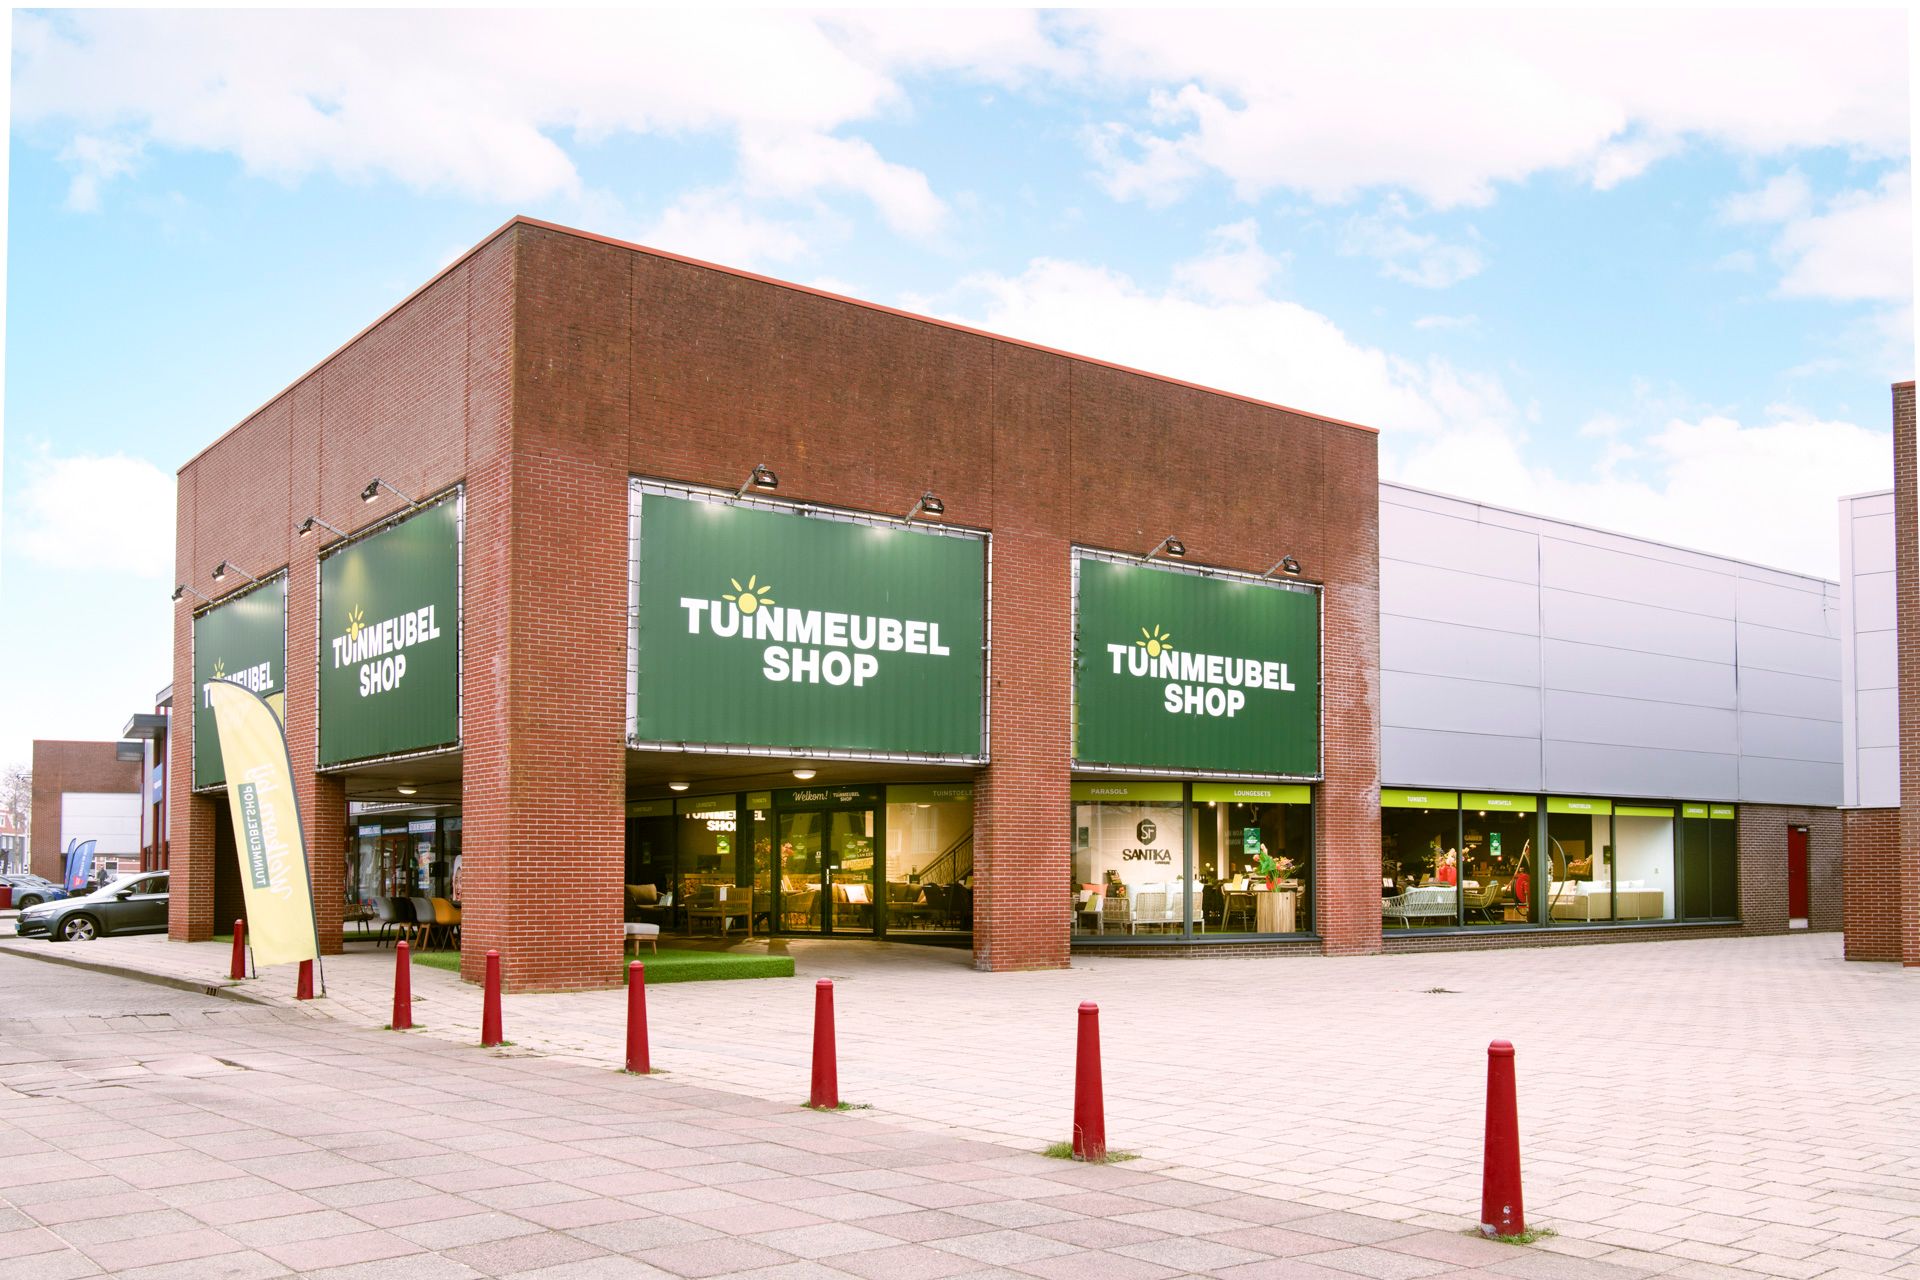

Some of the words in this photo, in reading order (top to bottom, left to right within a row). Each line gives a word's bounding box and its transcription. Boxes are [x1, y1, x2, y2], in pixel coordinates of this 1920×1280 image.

[332, 604, 440, 669] TUINMEUBEL
[680, 597, 950, 656] TUINMEUBEL
[360, 654, 407, 698] SHOP
[763, 645, 879, 687] SHOP
[1107, 643, 1296, 691] TUINMEUBEL
[1164, 683, 1246, 718] SHOP
[792, 791, 829, 802] Welkom!
[1090, 788, 1129, 796] PARASOLS
[1233, 790, 1272, 798] LOUNGESETS
[706, 820, 737, 832] SHO
[1122, 848, 1172, 862] SANTIKA
